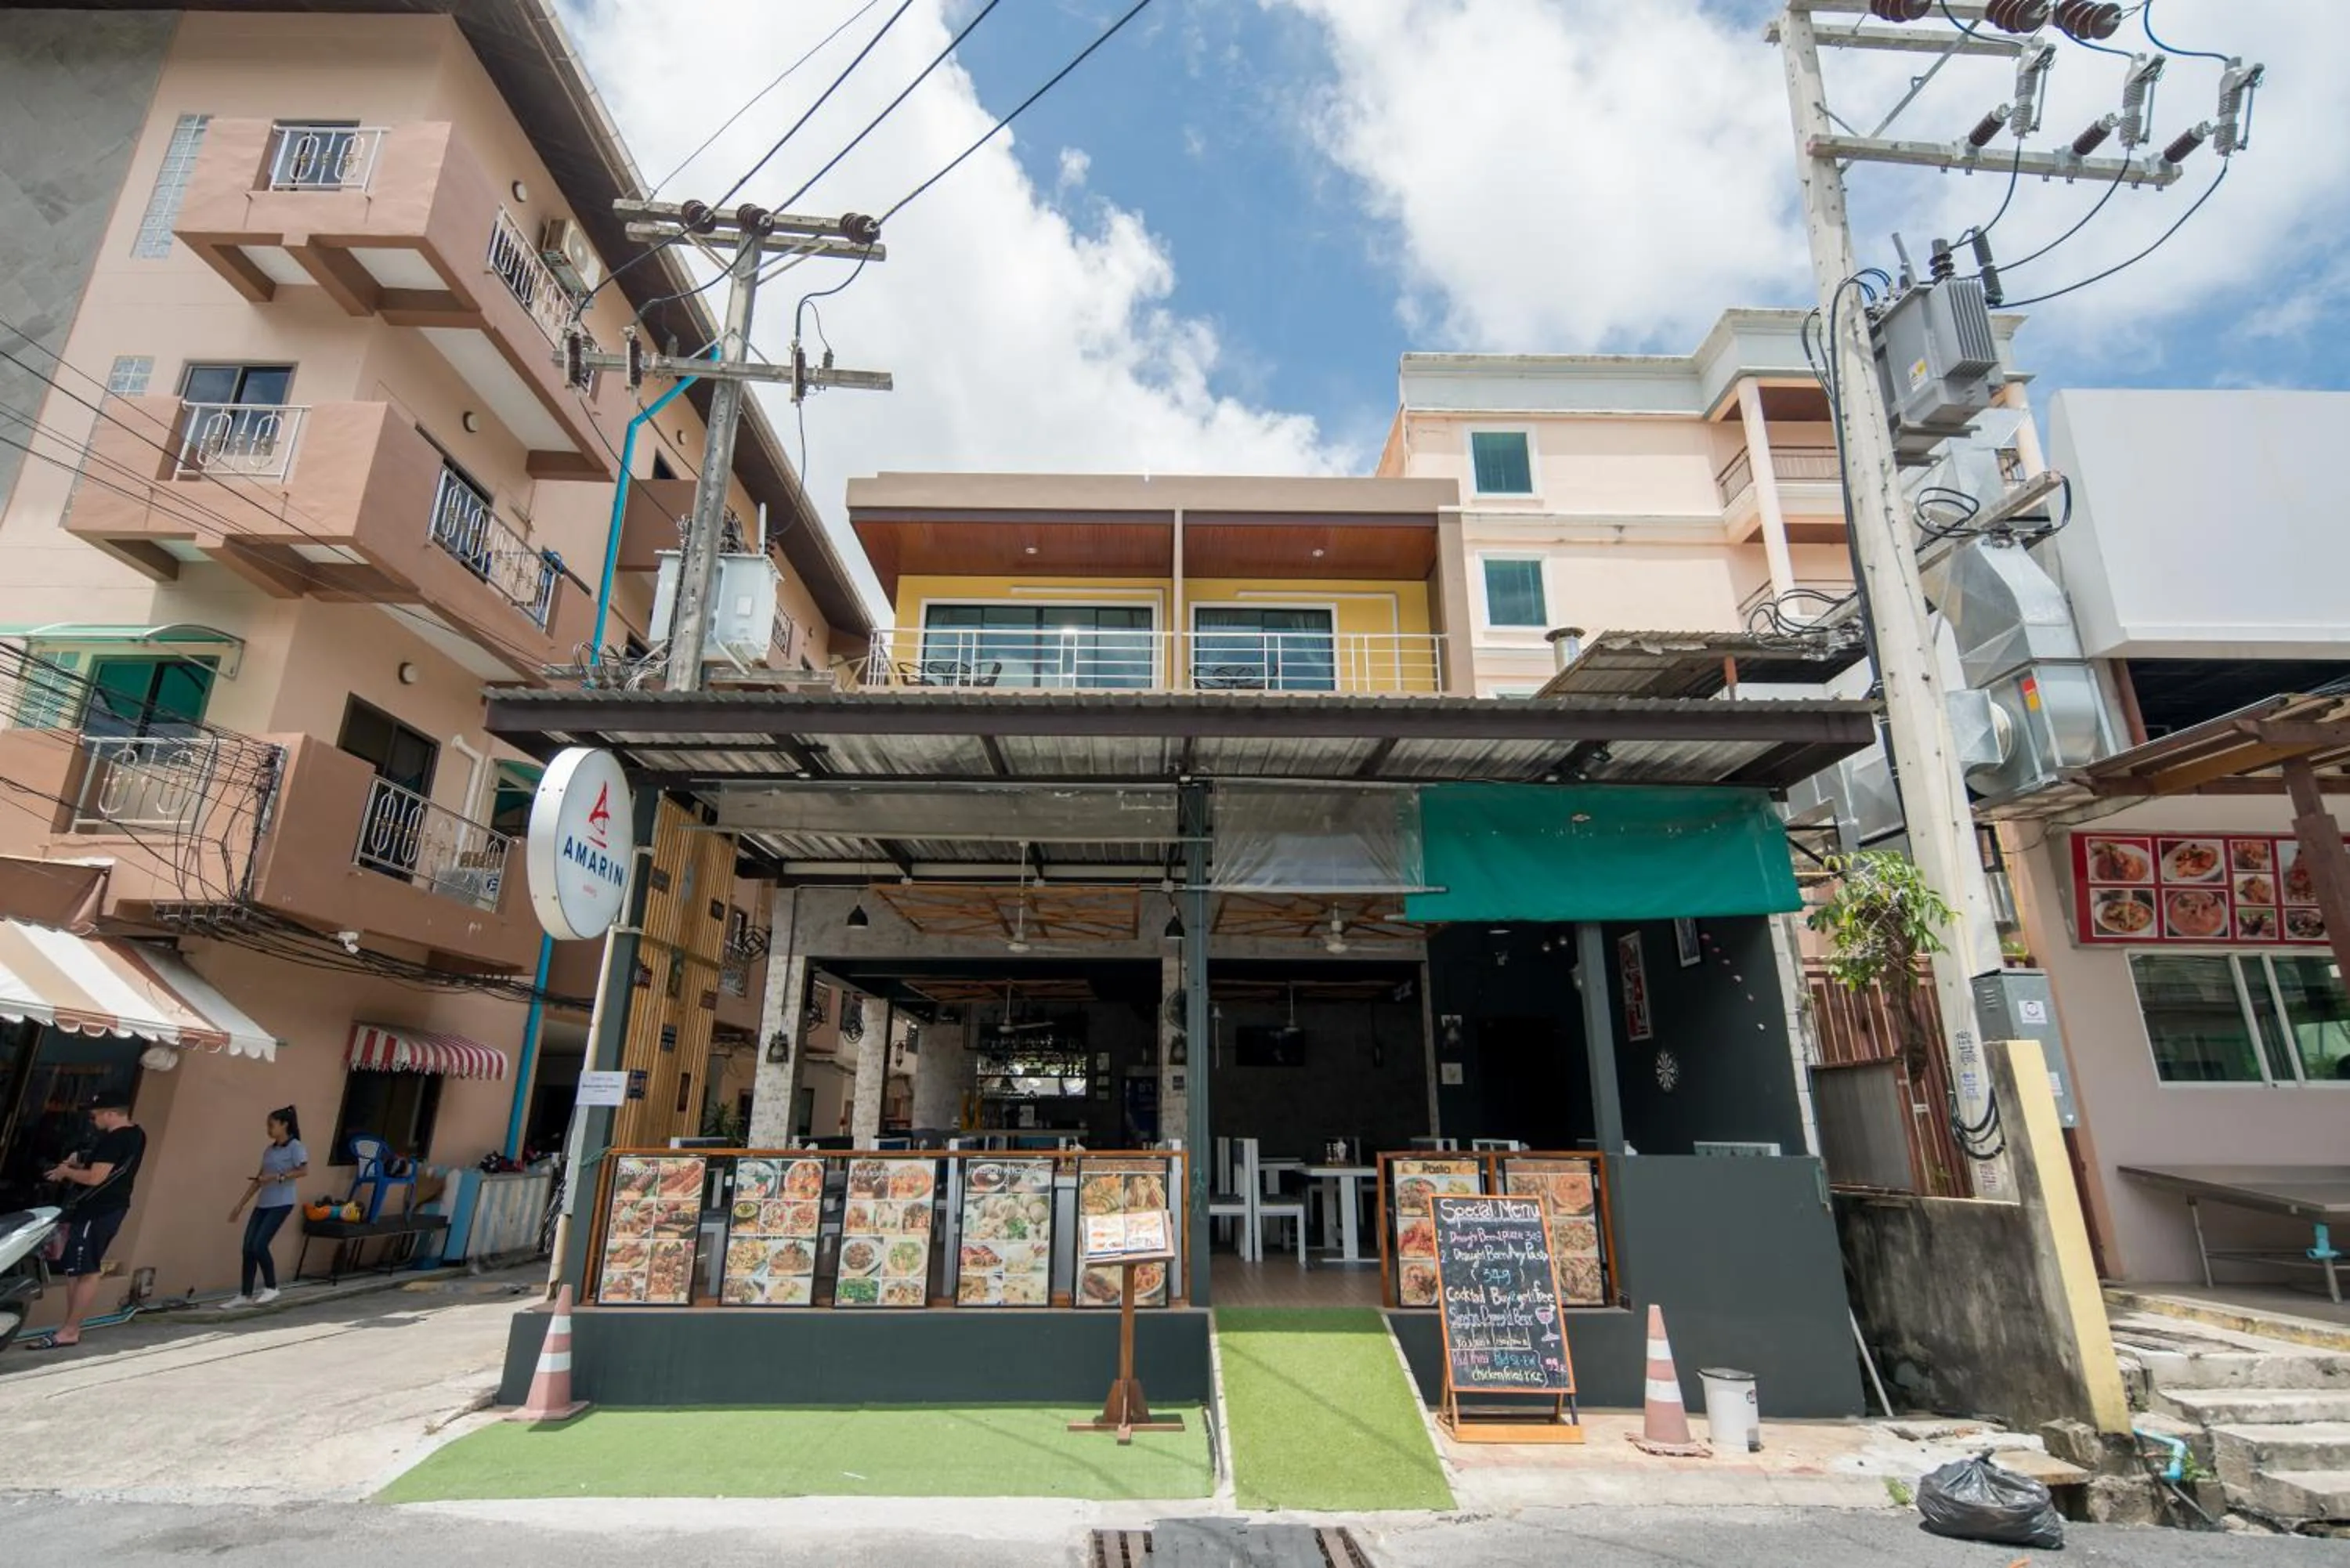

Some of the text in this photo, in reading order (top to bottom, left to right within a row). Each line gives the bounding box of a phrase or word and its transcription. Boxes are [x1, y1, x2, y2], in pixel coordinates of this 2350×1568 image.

[563, 835, 624, 887] AMARIN
[1422, 1162, 1451, 1174] Pasta
[1440, 1198, 1542, 1229] Special Menu
[1445, 1284, 1485, 1304] Cocktail
